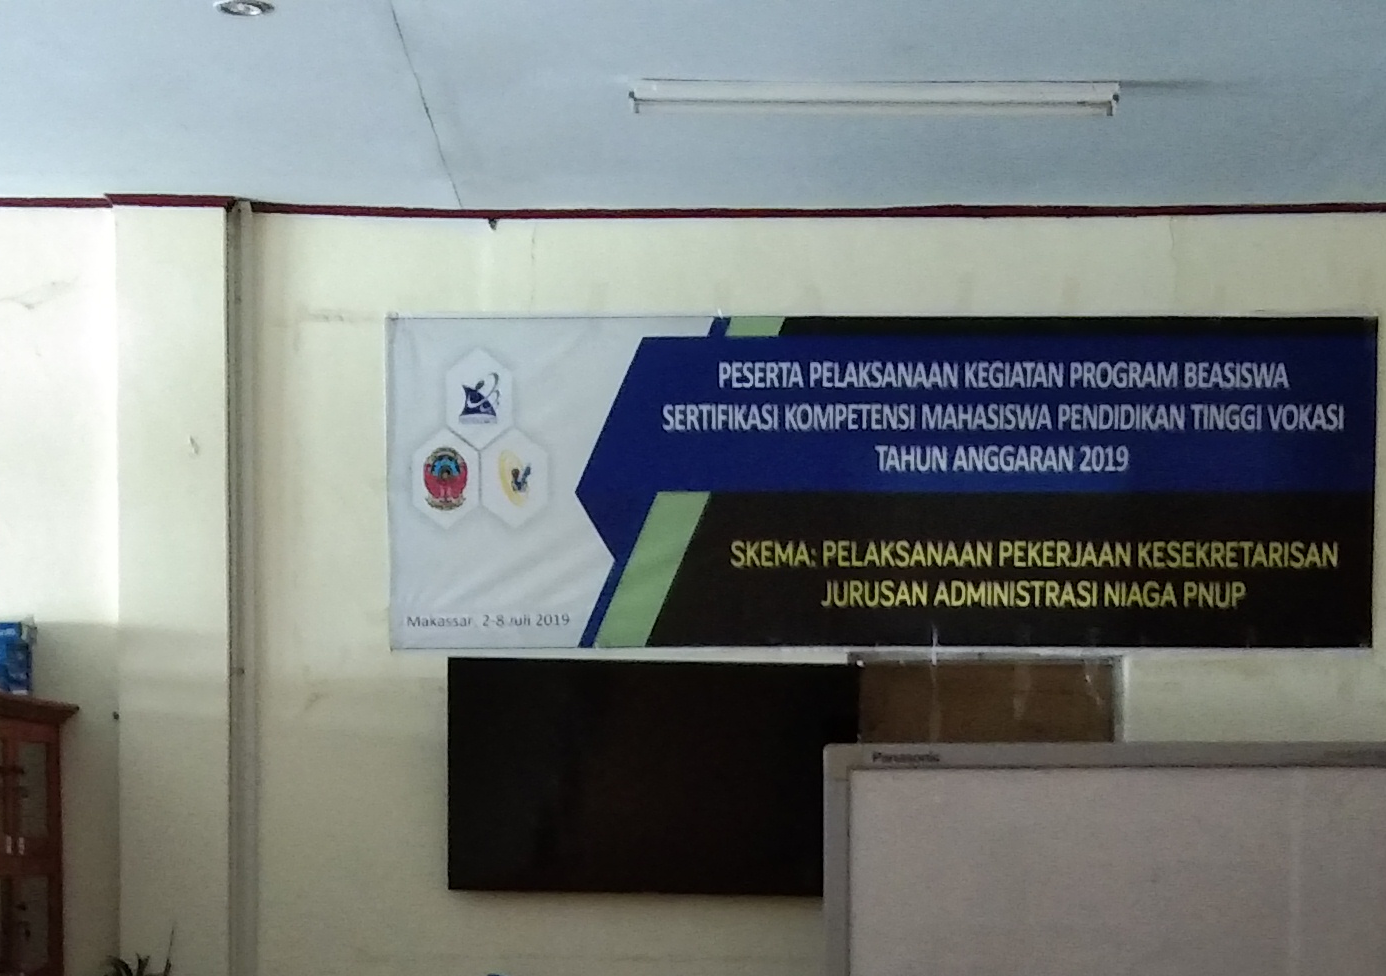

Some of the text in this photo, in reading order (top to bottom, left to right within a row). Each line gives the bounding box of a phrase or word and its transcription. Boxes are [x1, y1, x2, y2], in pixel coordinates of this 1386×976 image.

[718, 361, 1289, 388] PESERTA PELAKSANAAN KEGIATAN PROGRAM BEASISWA
[662, 403, 1344, 431] SERTIFIKASI KOMPETENSI MAHASISWA PENDIDIKAN TINGGI VOKASI
[875, 445, 1129, 472] TAHUN ANGGARAN 2019
[730, 540, 1338, 568] SKEMA: PELAKSANAAN PEKERJAAN KESEKRETARISAN
[820, 580, 1246, 609] JURUSAN ADMINISTRASI NIAGA PNUP
[482, 614, 505, 627] 2-8
[535, 614, 570, 627] 2019
[872, 752, 940, 763] Panasonic
